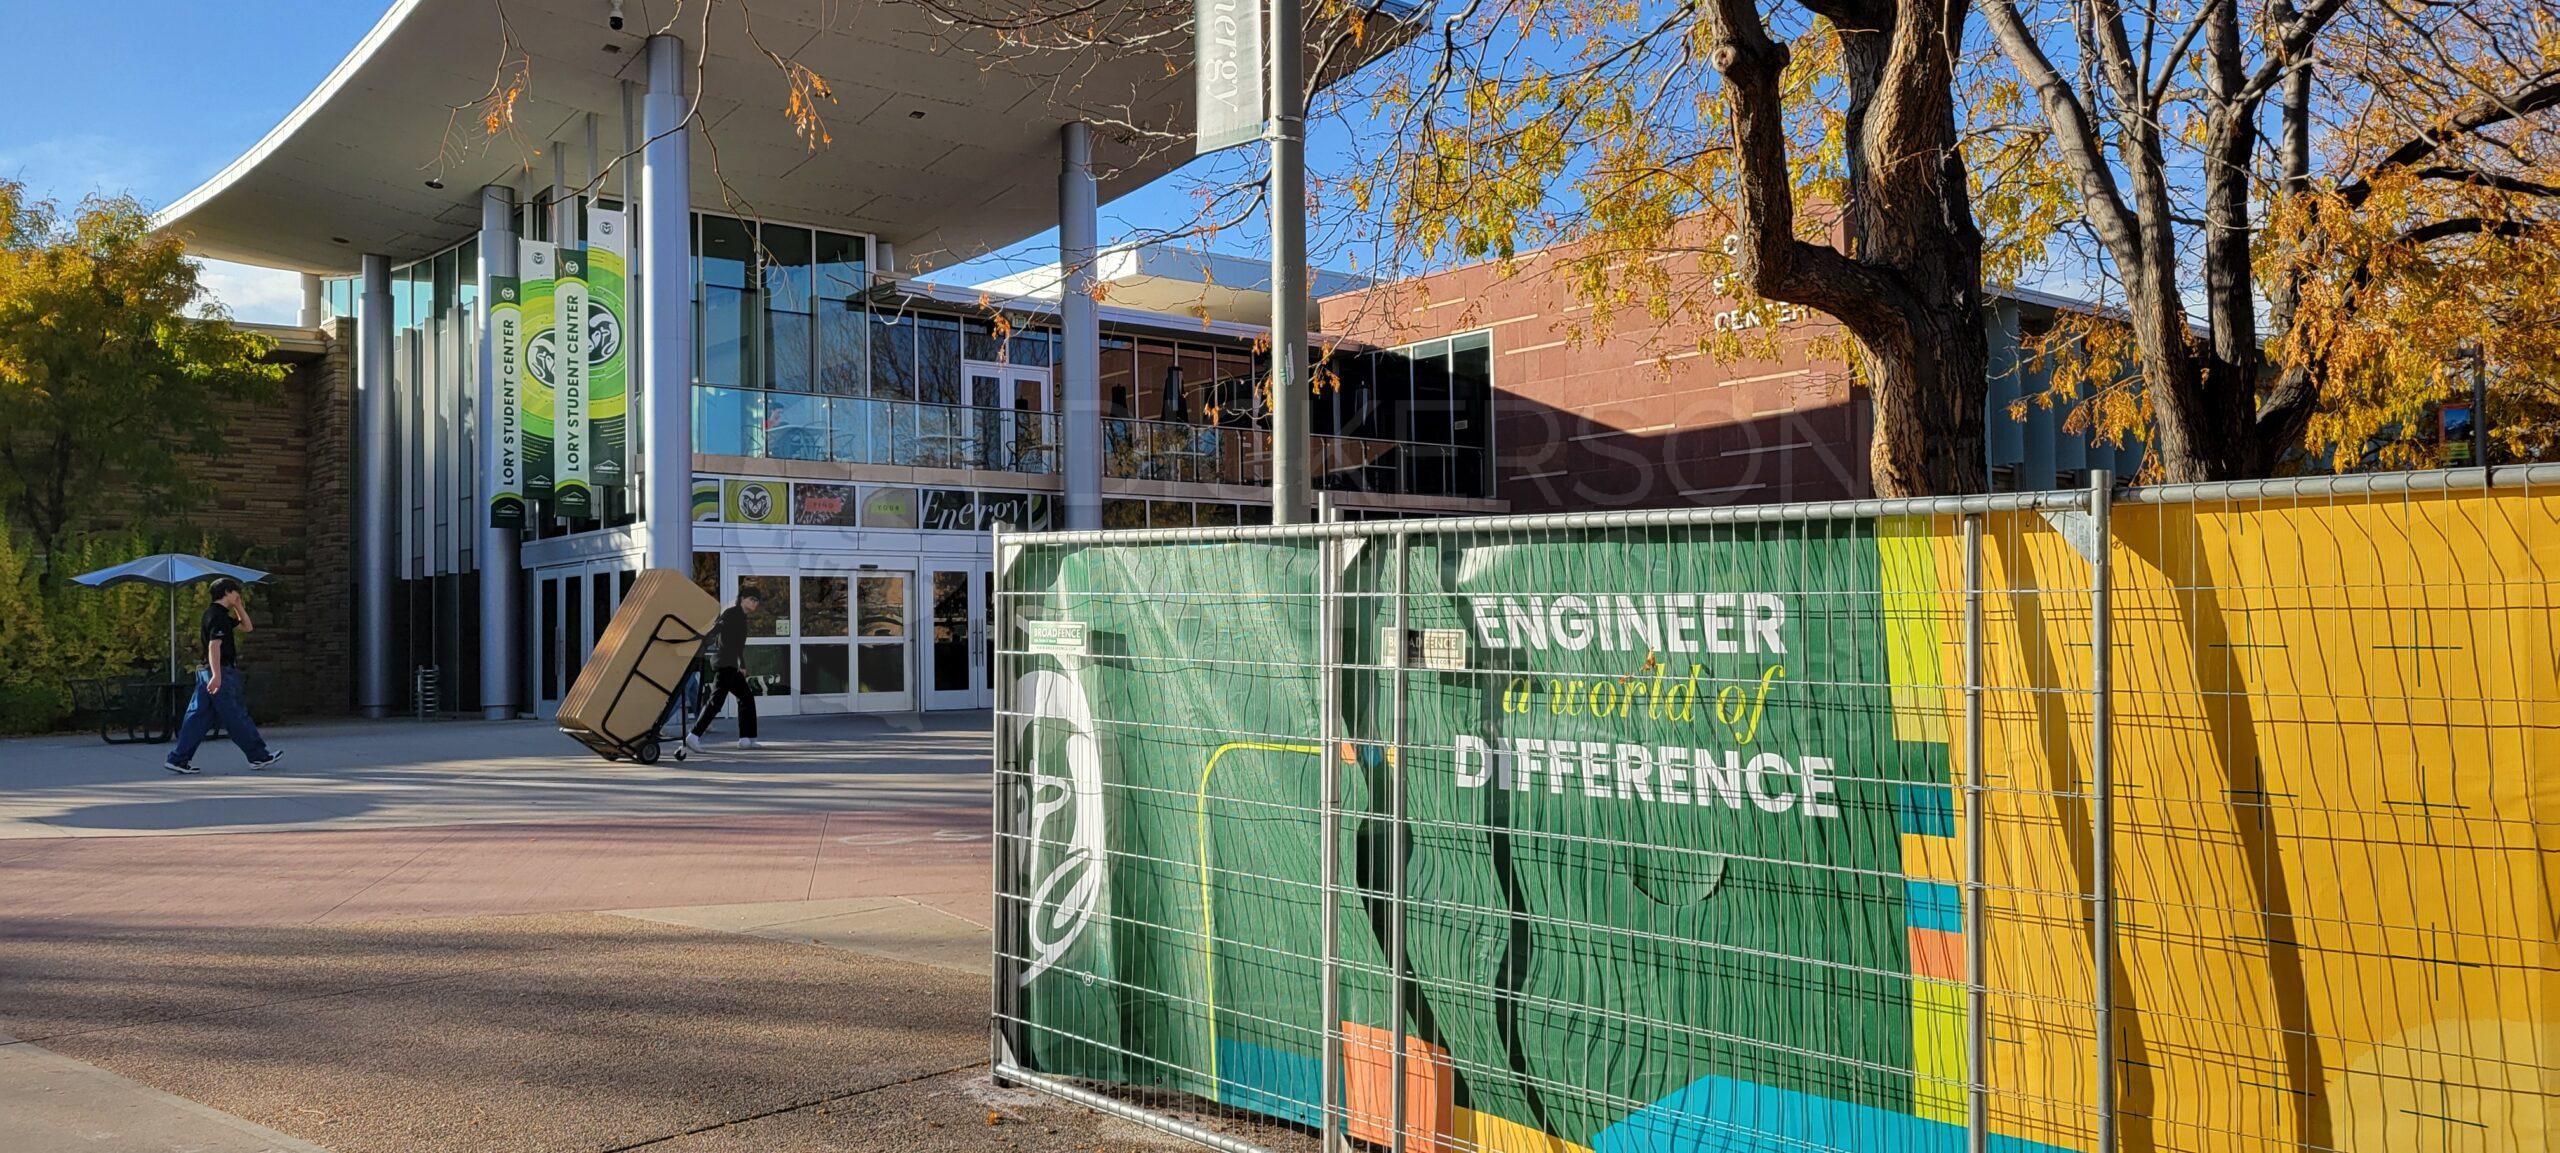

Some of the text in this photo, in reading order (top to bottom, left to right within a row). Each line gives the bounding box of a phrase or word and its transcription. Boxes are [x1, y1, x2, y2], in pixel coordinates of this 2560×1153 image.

[503, 319, 515, 486] LORY STUDENT CENTER
[567, 295, 579, 472] LORY STUDENT CENTER
[922, 489, 1028, 531] Energy
[1033, 627, 1081, 639] BROADFENCE
[1388, 635, 1457, 650] BADFENCE
[1472, 592, 1789, 655] ENGINEER
[1502, 663, 1787, 745] a world of
[1455, 734, 1840, 819] DIFFERENCE
